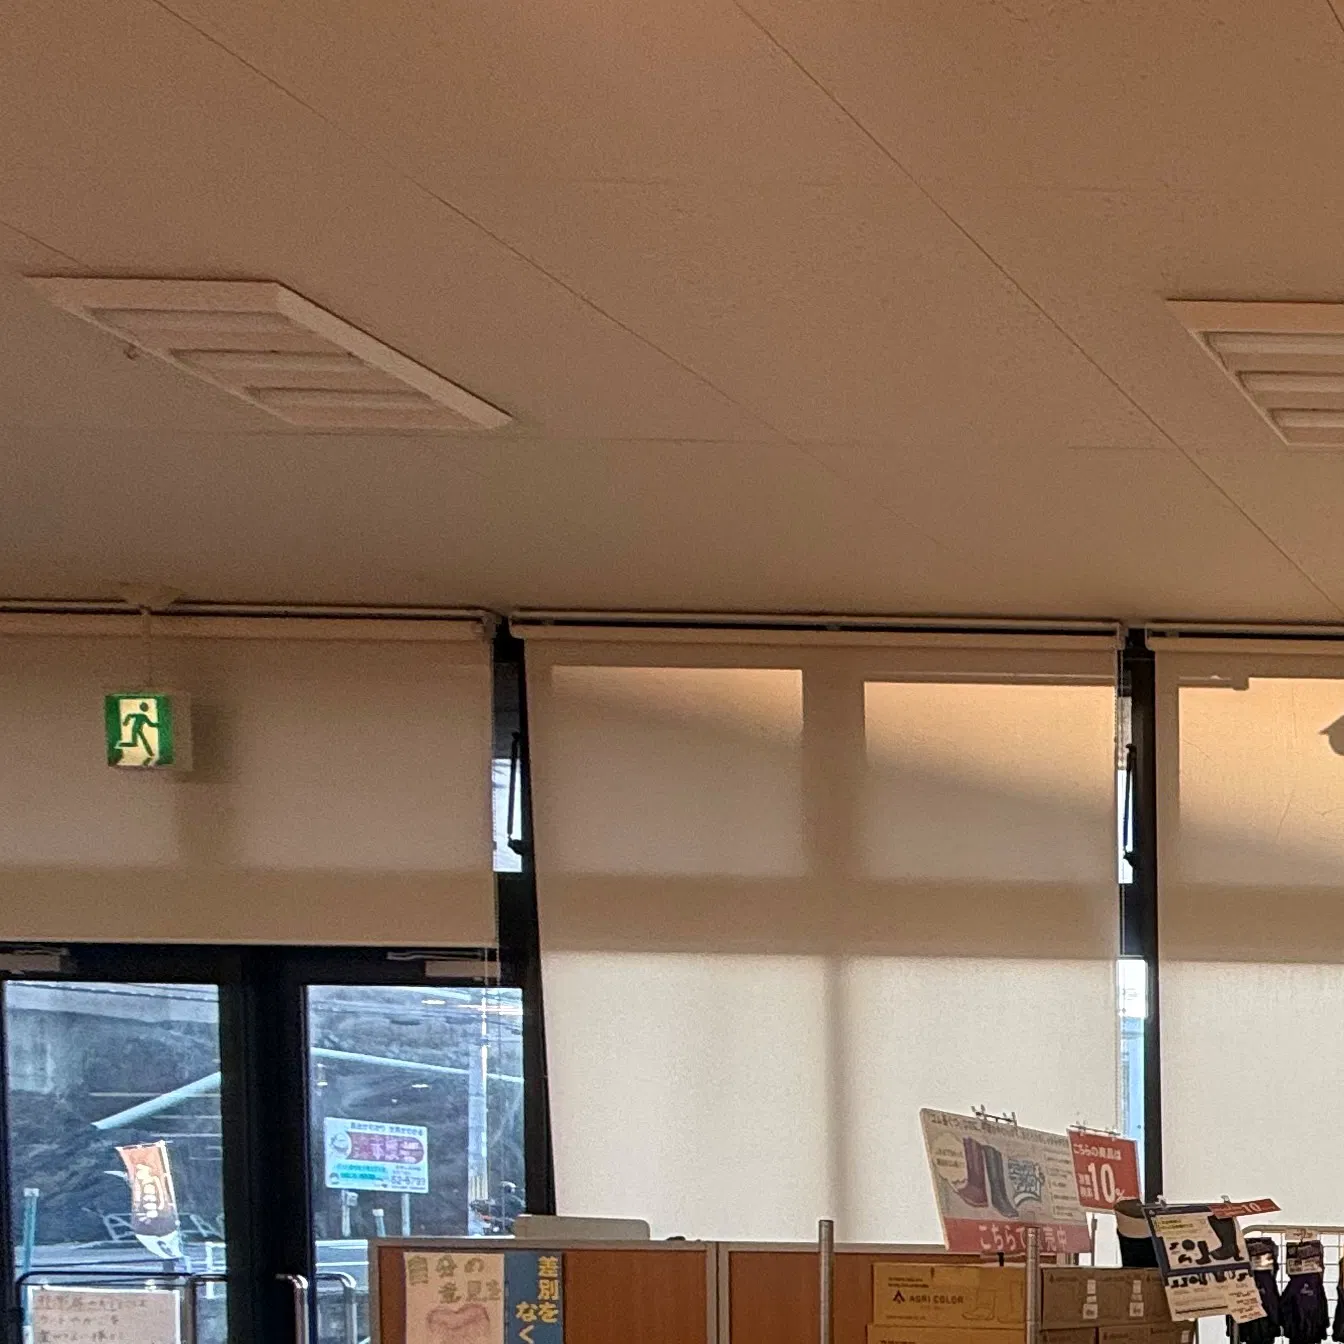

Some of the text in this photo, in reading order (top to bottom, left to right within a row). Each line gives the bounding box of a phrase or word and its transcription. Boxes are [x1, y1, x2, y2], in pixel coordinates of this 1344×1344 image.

[978, 1223, 1068, 1252] こちらで売中
[538, 1255, 560, 1324] 差別を
